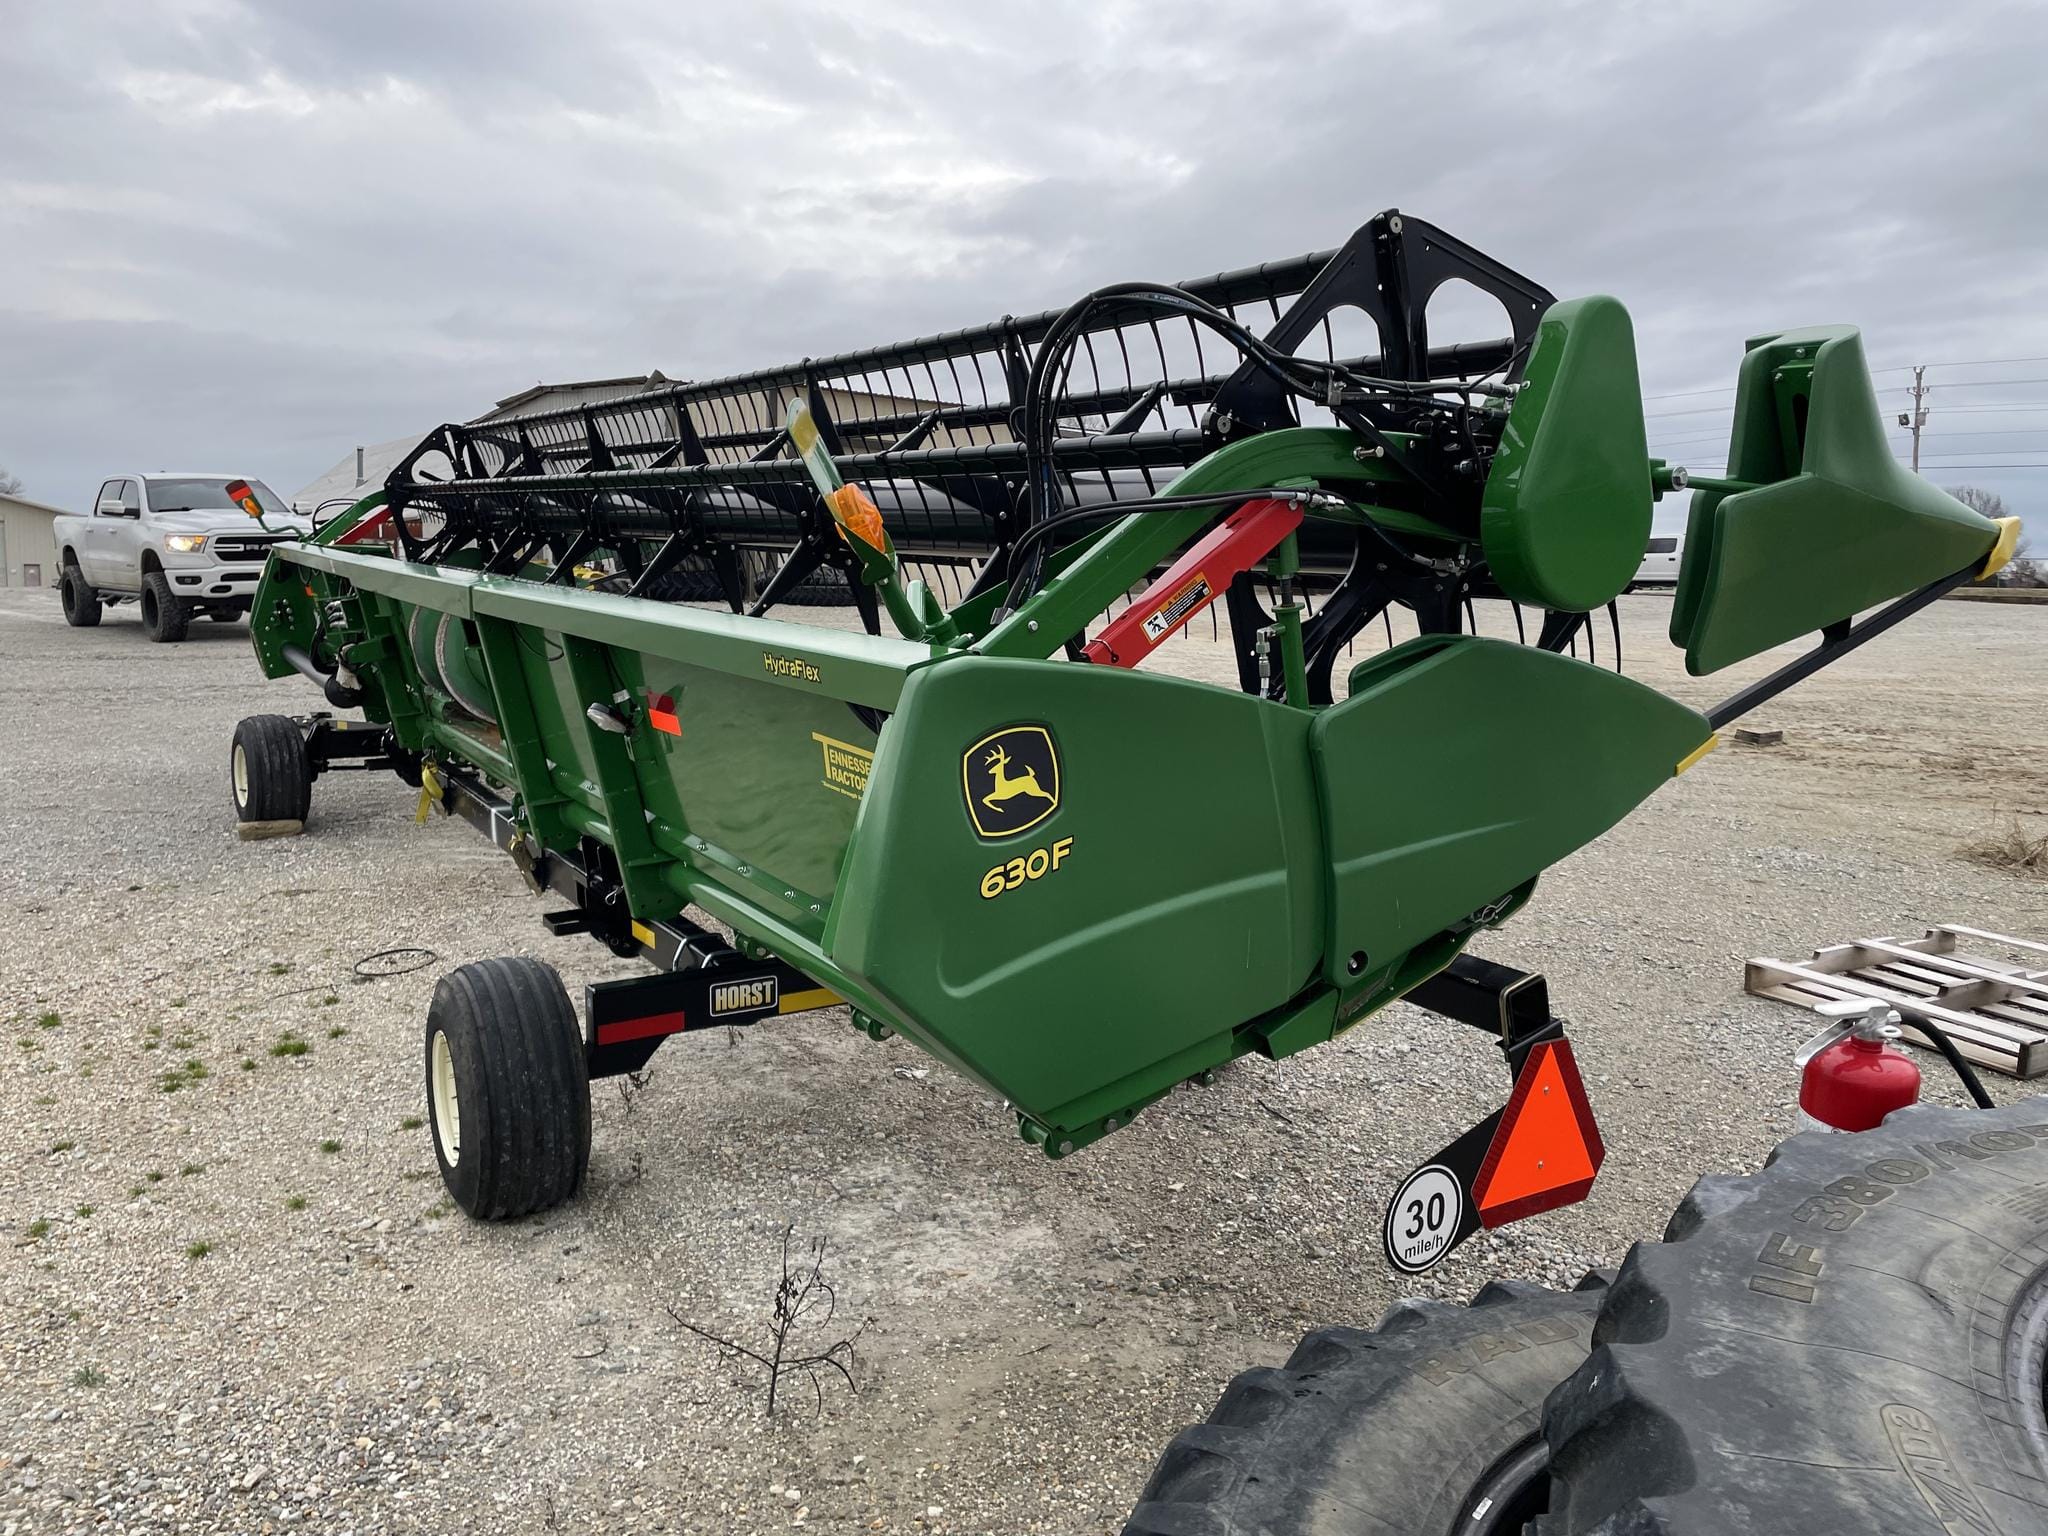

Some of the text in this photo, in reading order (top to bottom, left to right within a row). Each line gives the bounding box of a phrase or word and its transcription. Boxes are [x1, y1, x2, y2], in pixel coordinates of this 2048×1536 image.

[763, 652, 821, 682] HydraFlex
[980, 836, 1074, 899] 630F
[715, 980, 774, 1012] HORST
[1405, 1192, 1446, 1239] 30
[1404, 1234, 1443, 1259] mile/h
[1404, 1309, 1598, 1387] RAD
